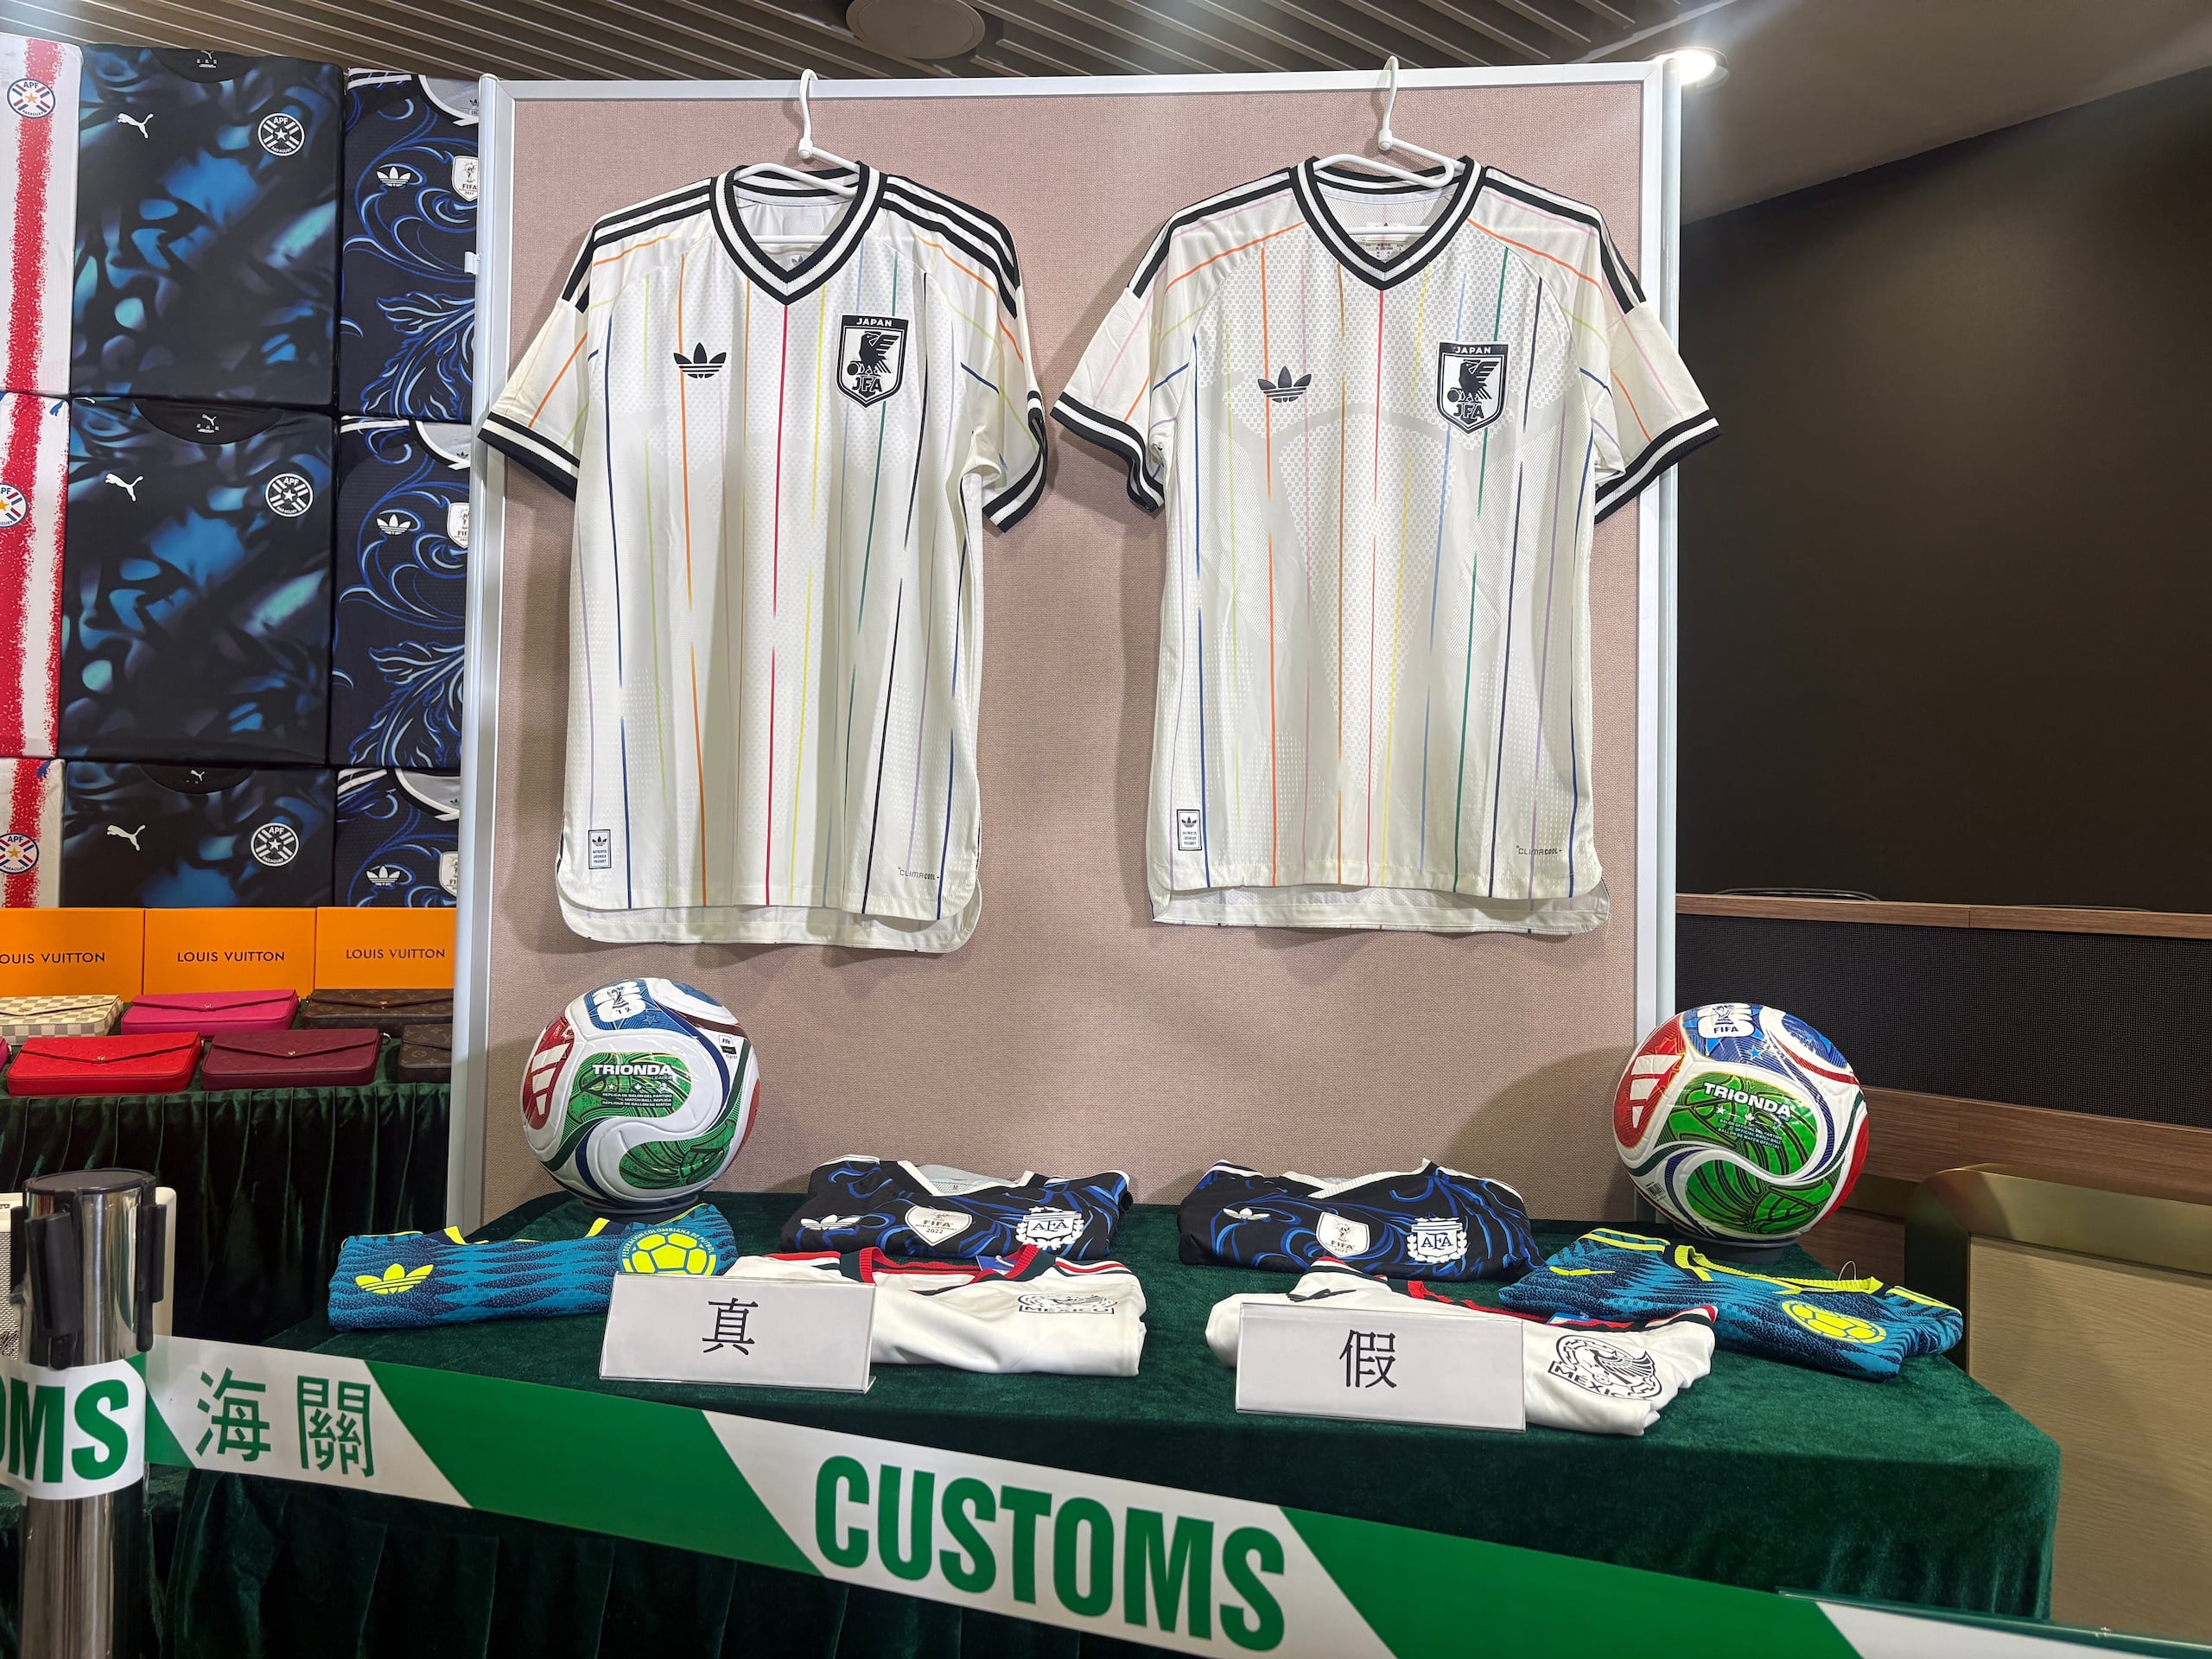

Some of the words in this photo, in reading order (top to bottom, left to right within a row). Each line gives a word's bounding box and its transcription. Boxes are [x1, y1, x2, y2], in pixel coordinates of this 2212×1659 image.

[856, 318, 893, 327] JAPAN
[851, 377, 883, 392] JFA
[1452, 404, 1485, 419] JFA
[283, 477, 300, 486] APF
[268, 826, 285, 835] APF
[41, 952, 105, 963] VUITTON
[177, 951, 219, 962] LOUIS
[224, 950, 285, 962] VUITTON
[346, 948, 385, 959] LOUIS
[390, 948, 446, 959] VUITTON
[592, 1064, 673, 1076] TRIONDA
[1703, 1082, 1791, 1118] TRIONDA
[923, 1219, 950, 1228] FIFA
[1031, 1219, 1070, 1232] AFA
[1332, 1240, 1353, 1249] FIFA
[1421, 1232, 1454, 1250] AFA
[702, 1297, 759, 1356] 真
[1338, 1329, 1397, 1389] 假
[0, 1372, 130, 1484] MS
[195, 1367, 376, 1478] 海關
[815, 1455, 1285, 1652] CUSTOMS
